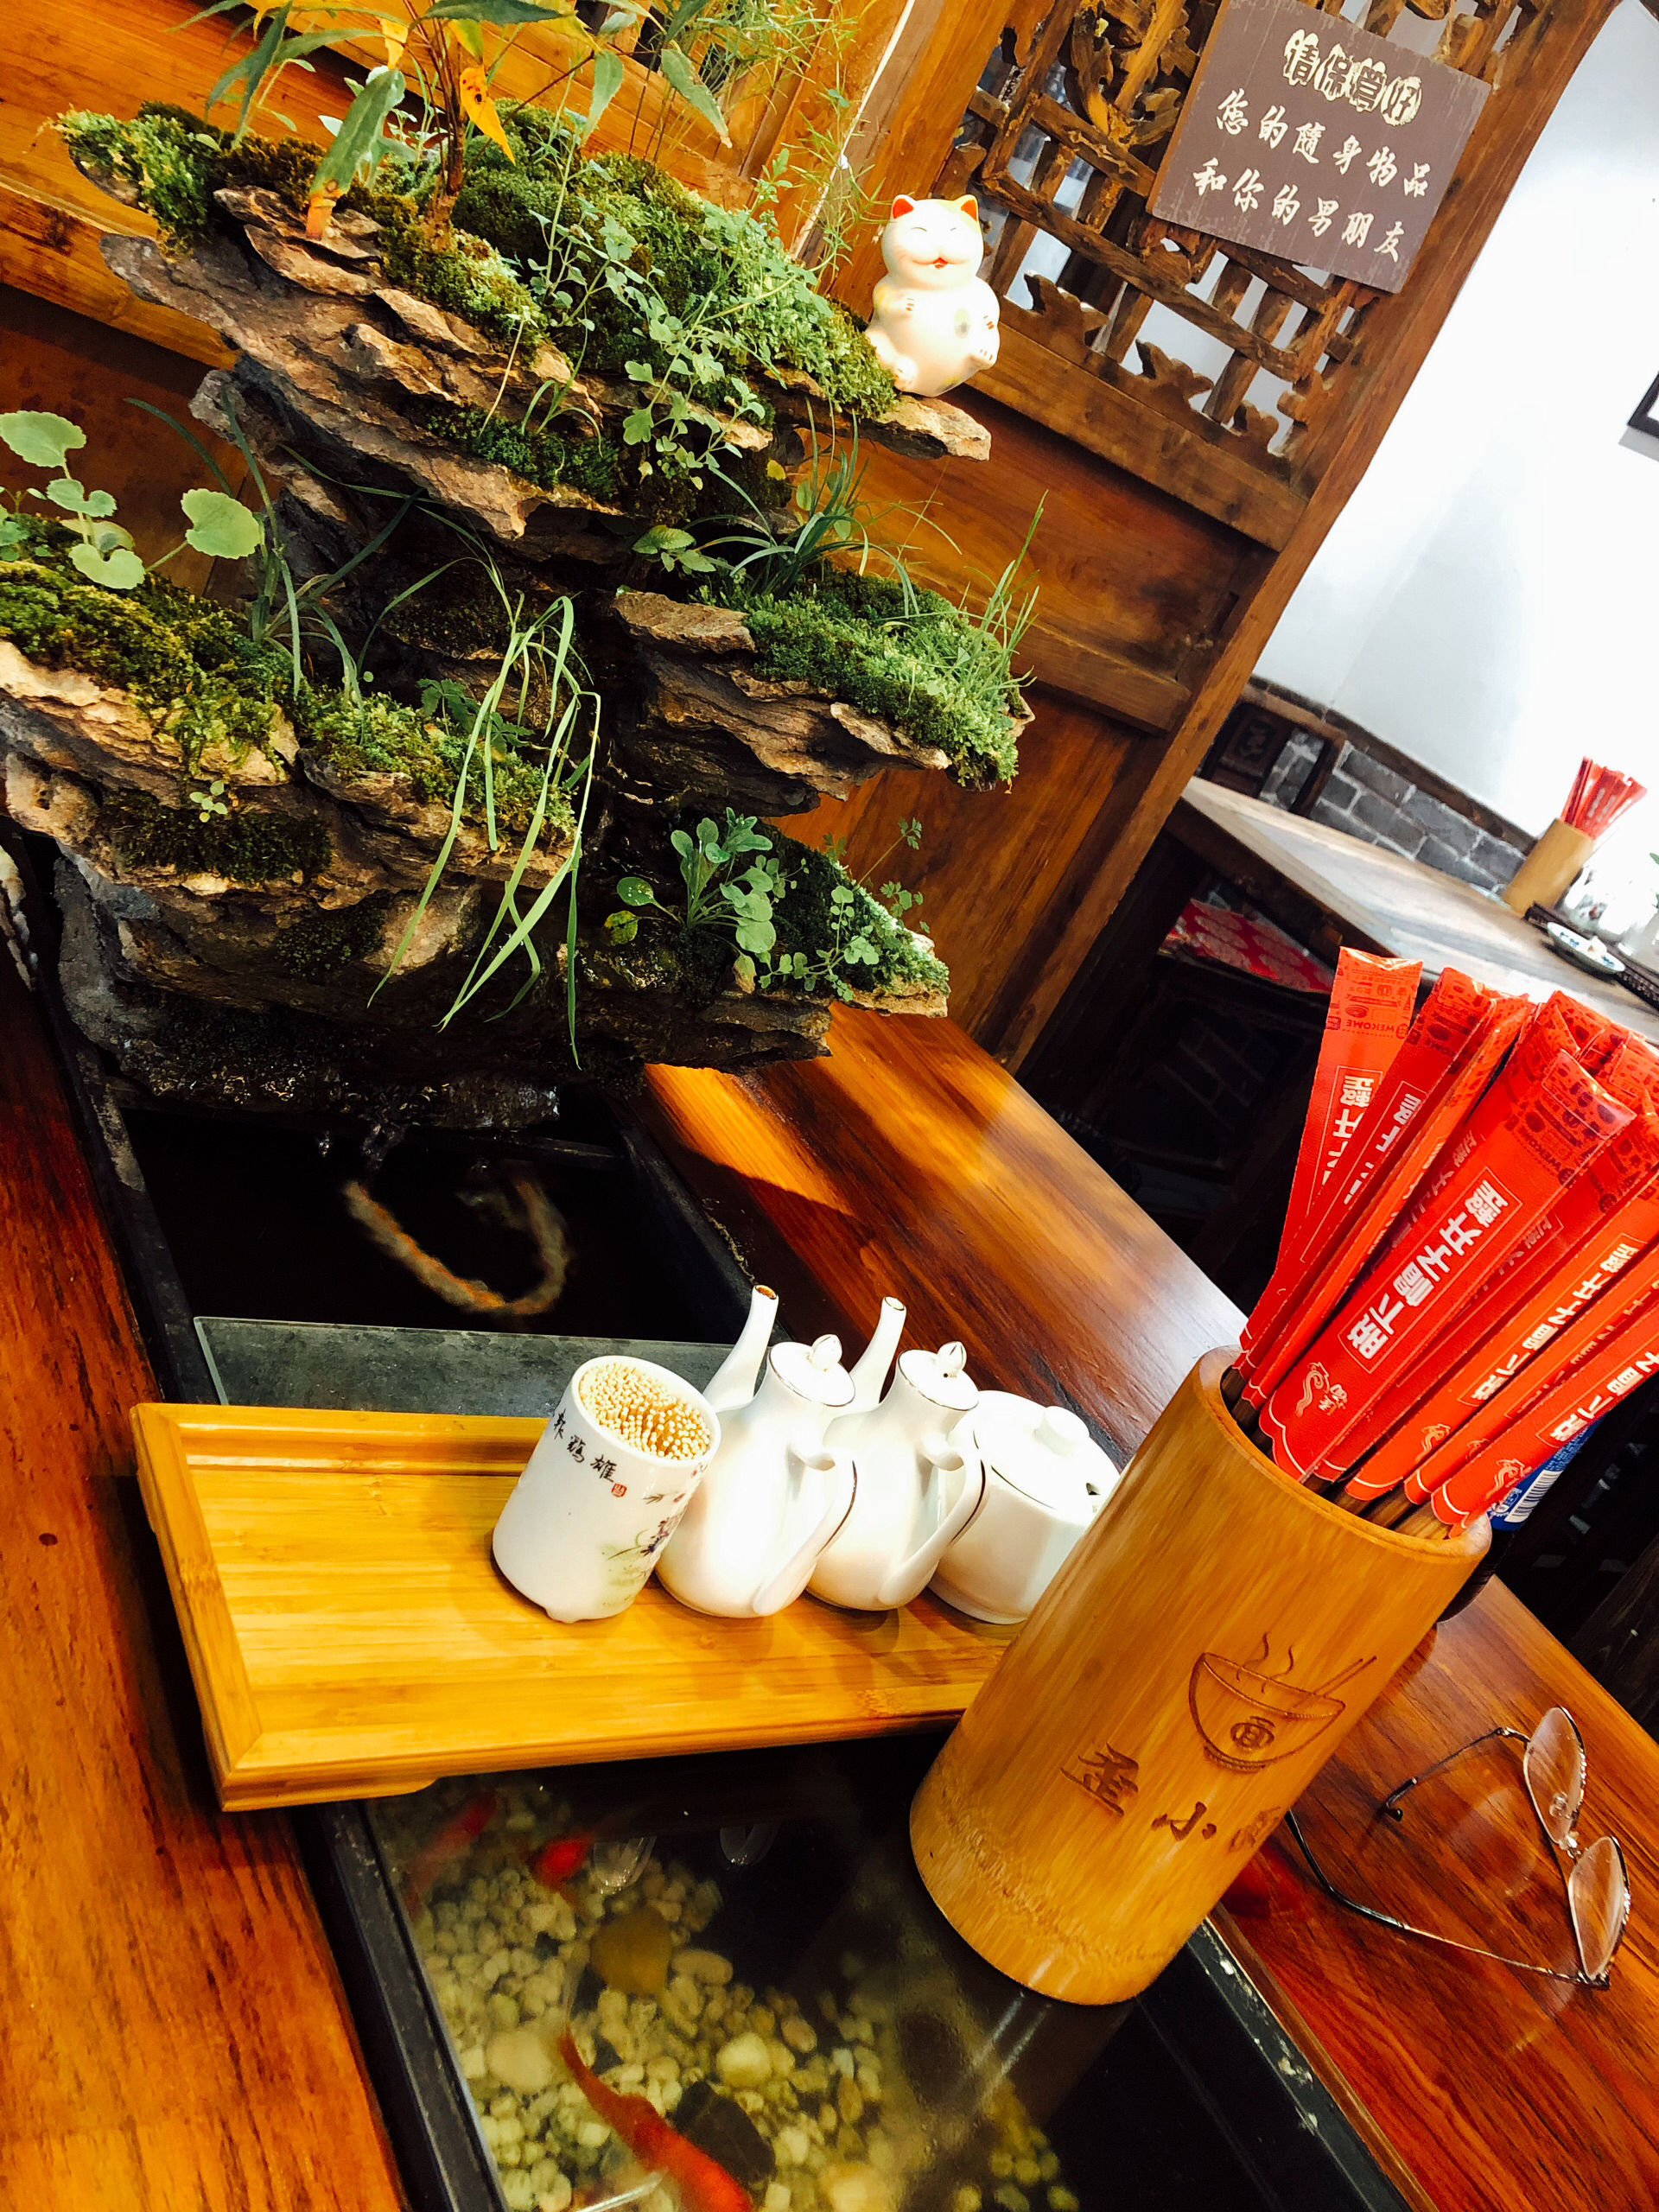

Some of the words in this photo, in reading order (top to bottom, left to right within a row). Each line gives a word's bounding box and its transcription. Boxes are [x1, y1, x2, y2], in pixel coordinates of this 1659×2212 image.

[1216, 87, 1431, 199] 您的隨身物品
[1192, 157, 1405, 263] 和你的男朋友
[1347, 1179, 1509, 1360] 脱下帽子开整
